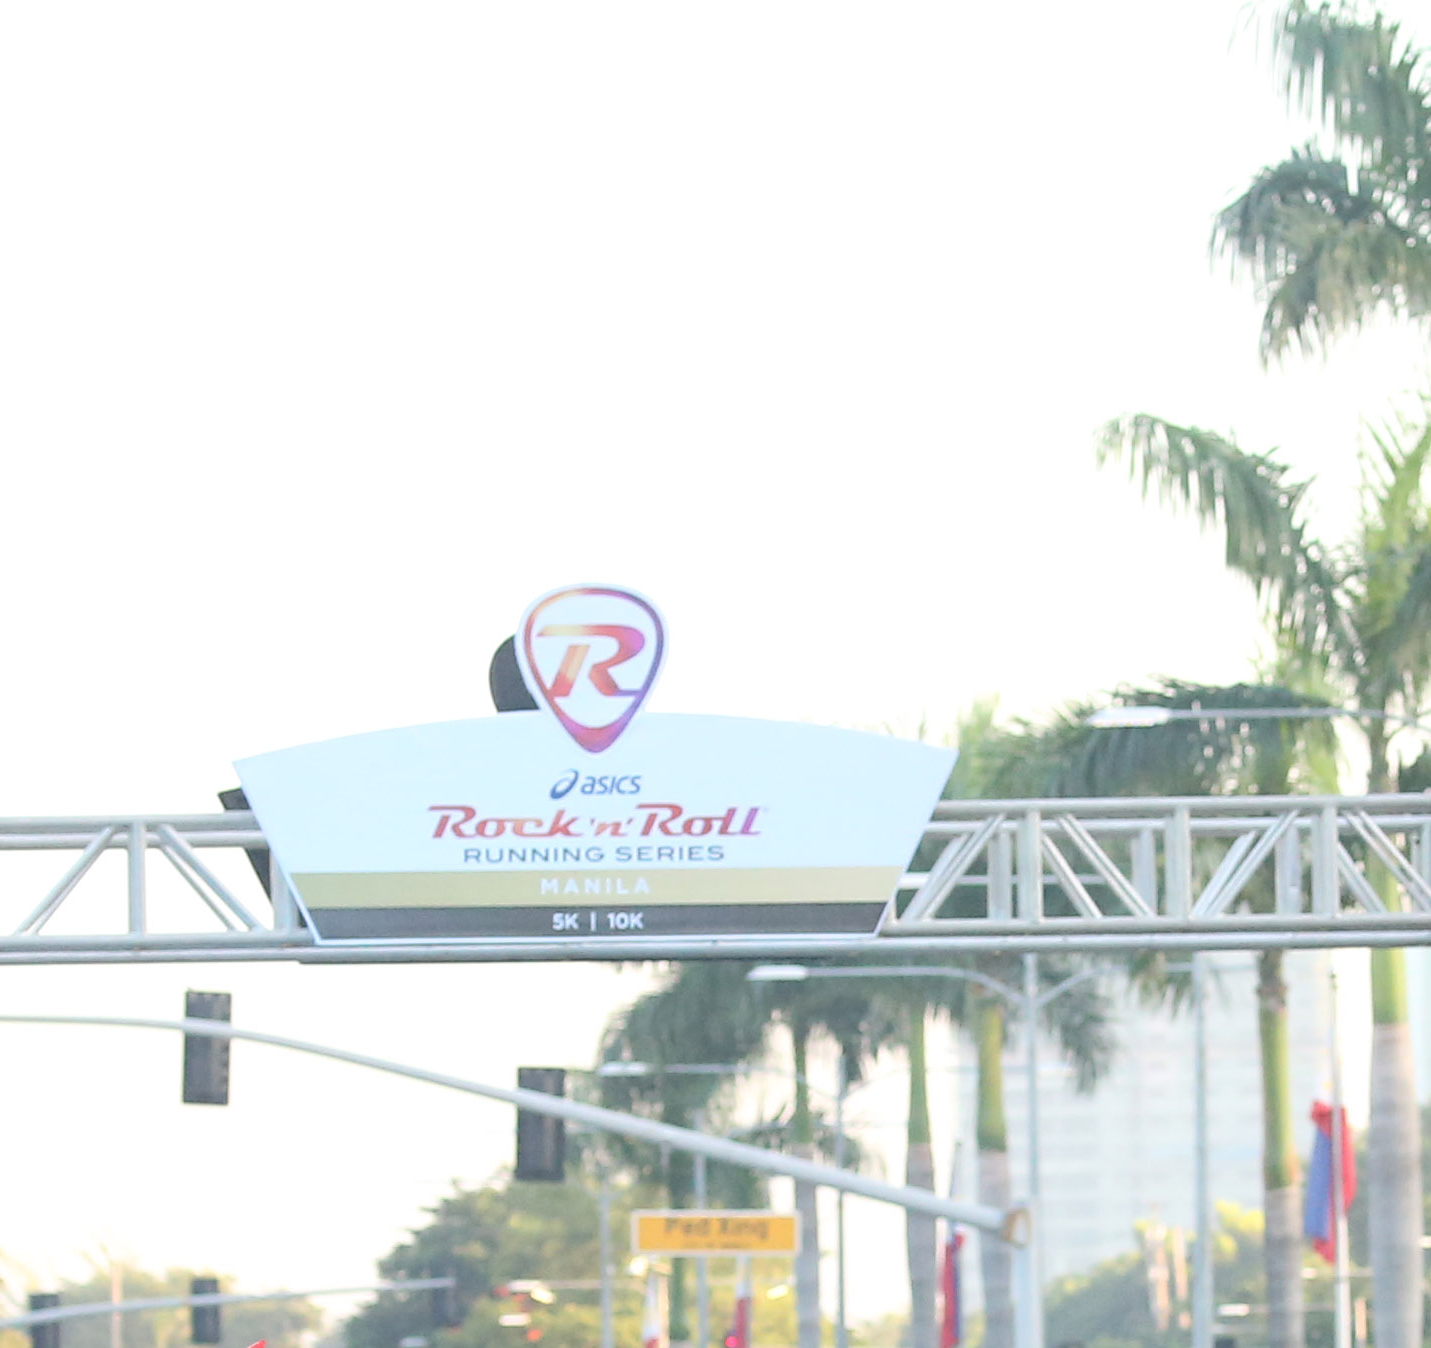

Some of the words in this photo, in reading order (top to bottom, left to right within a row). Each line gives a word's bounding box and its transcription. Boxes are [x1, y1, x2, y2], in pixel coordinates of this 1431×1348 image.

[580, 774, 642, 795] asics
[428, 805, 585, 839] Rock
[636, 803, 762, 838] Roll
[463, 847, 605, 864] RUNNING
[614, 845, 725, 863] SERIES
[539, 877, 651, 896] MANILA
[552, 912, 579, 931] 5K
[607, 912, 644, 931] 10K
